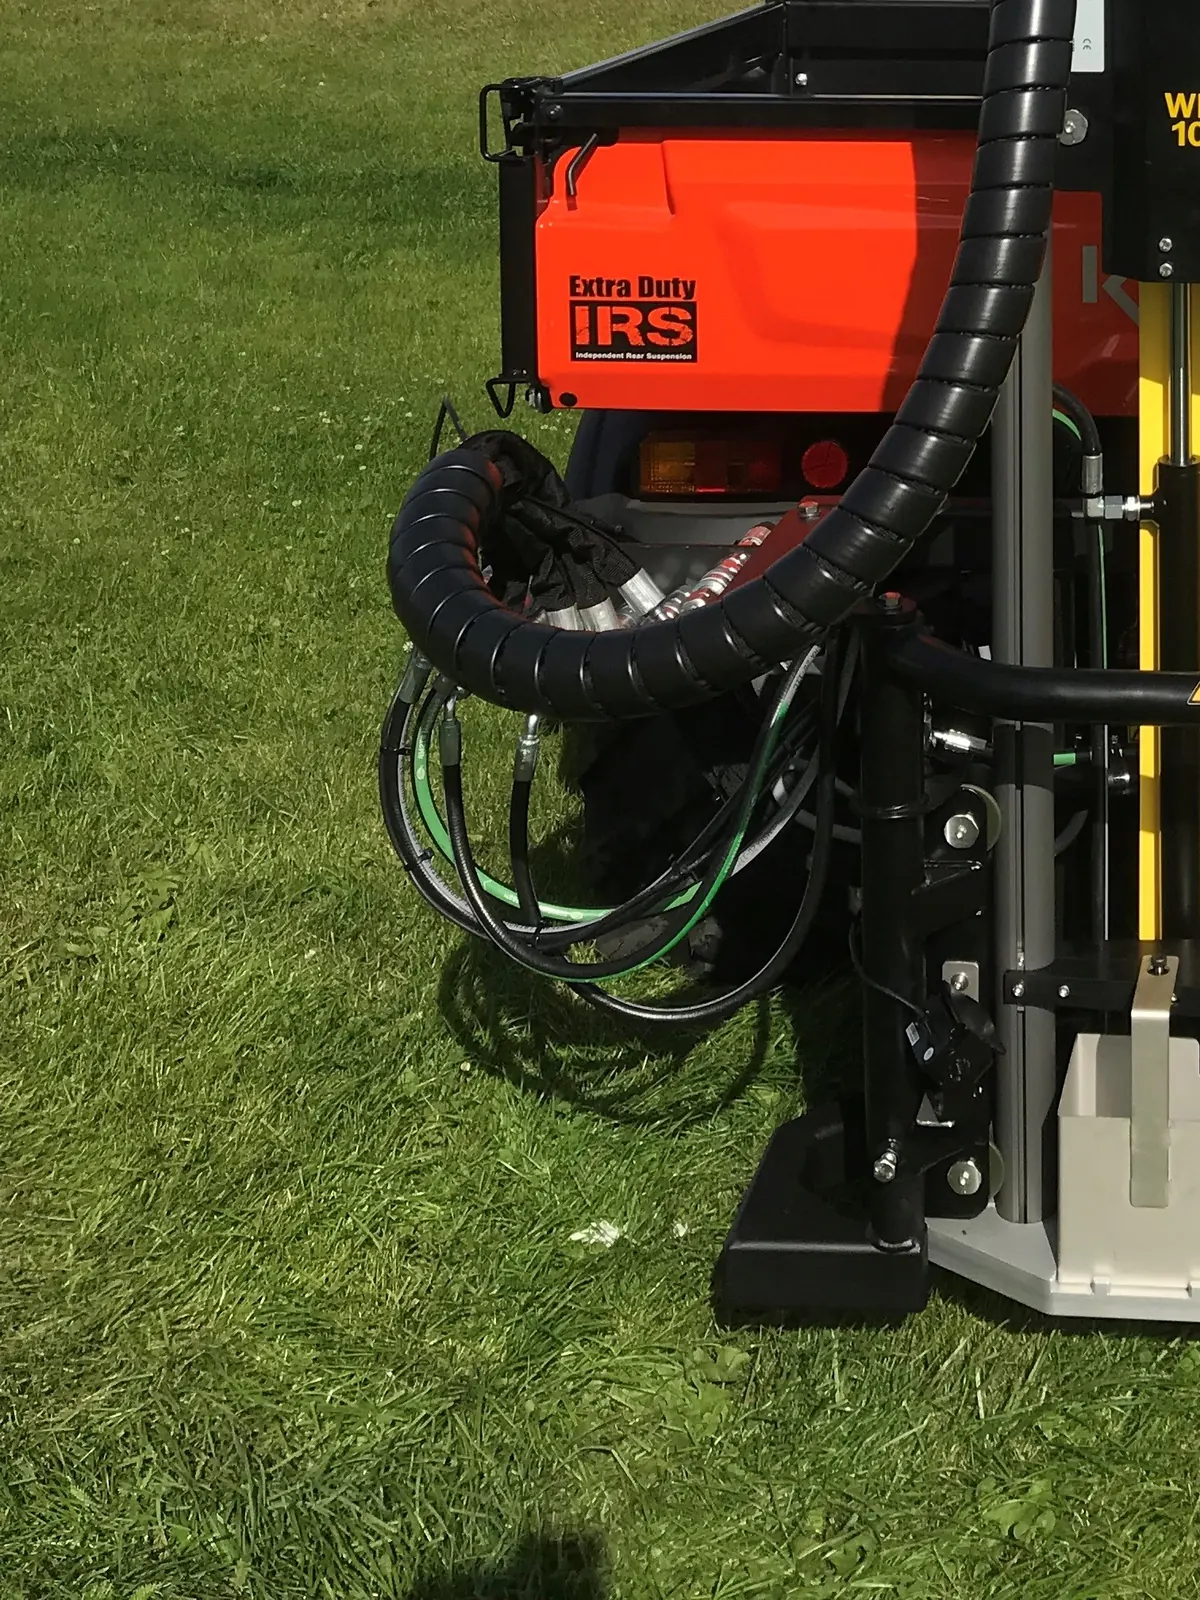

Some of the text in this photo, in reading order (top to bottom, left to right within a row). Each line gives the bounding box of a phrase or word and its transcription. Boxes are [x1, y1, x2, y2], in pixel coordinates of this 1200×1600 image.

[569, 275, 696, 301] Extra Duty
[575, 305, 694, 346] IRS
[575, 352, 692, 361] Independent Rear Suspension
